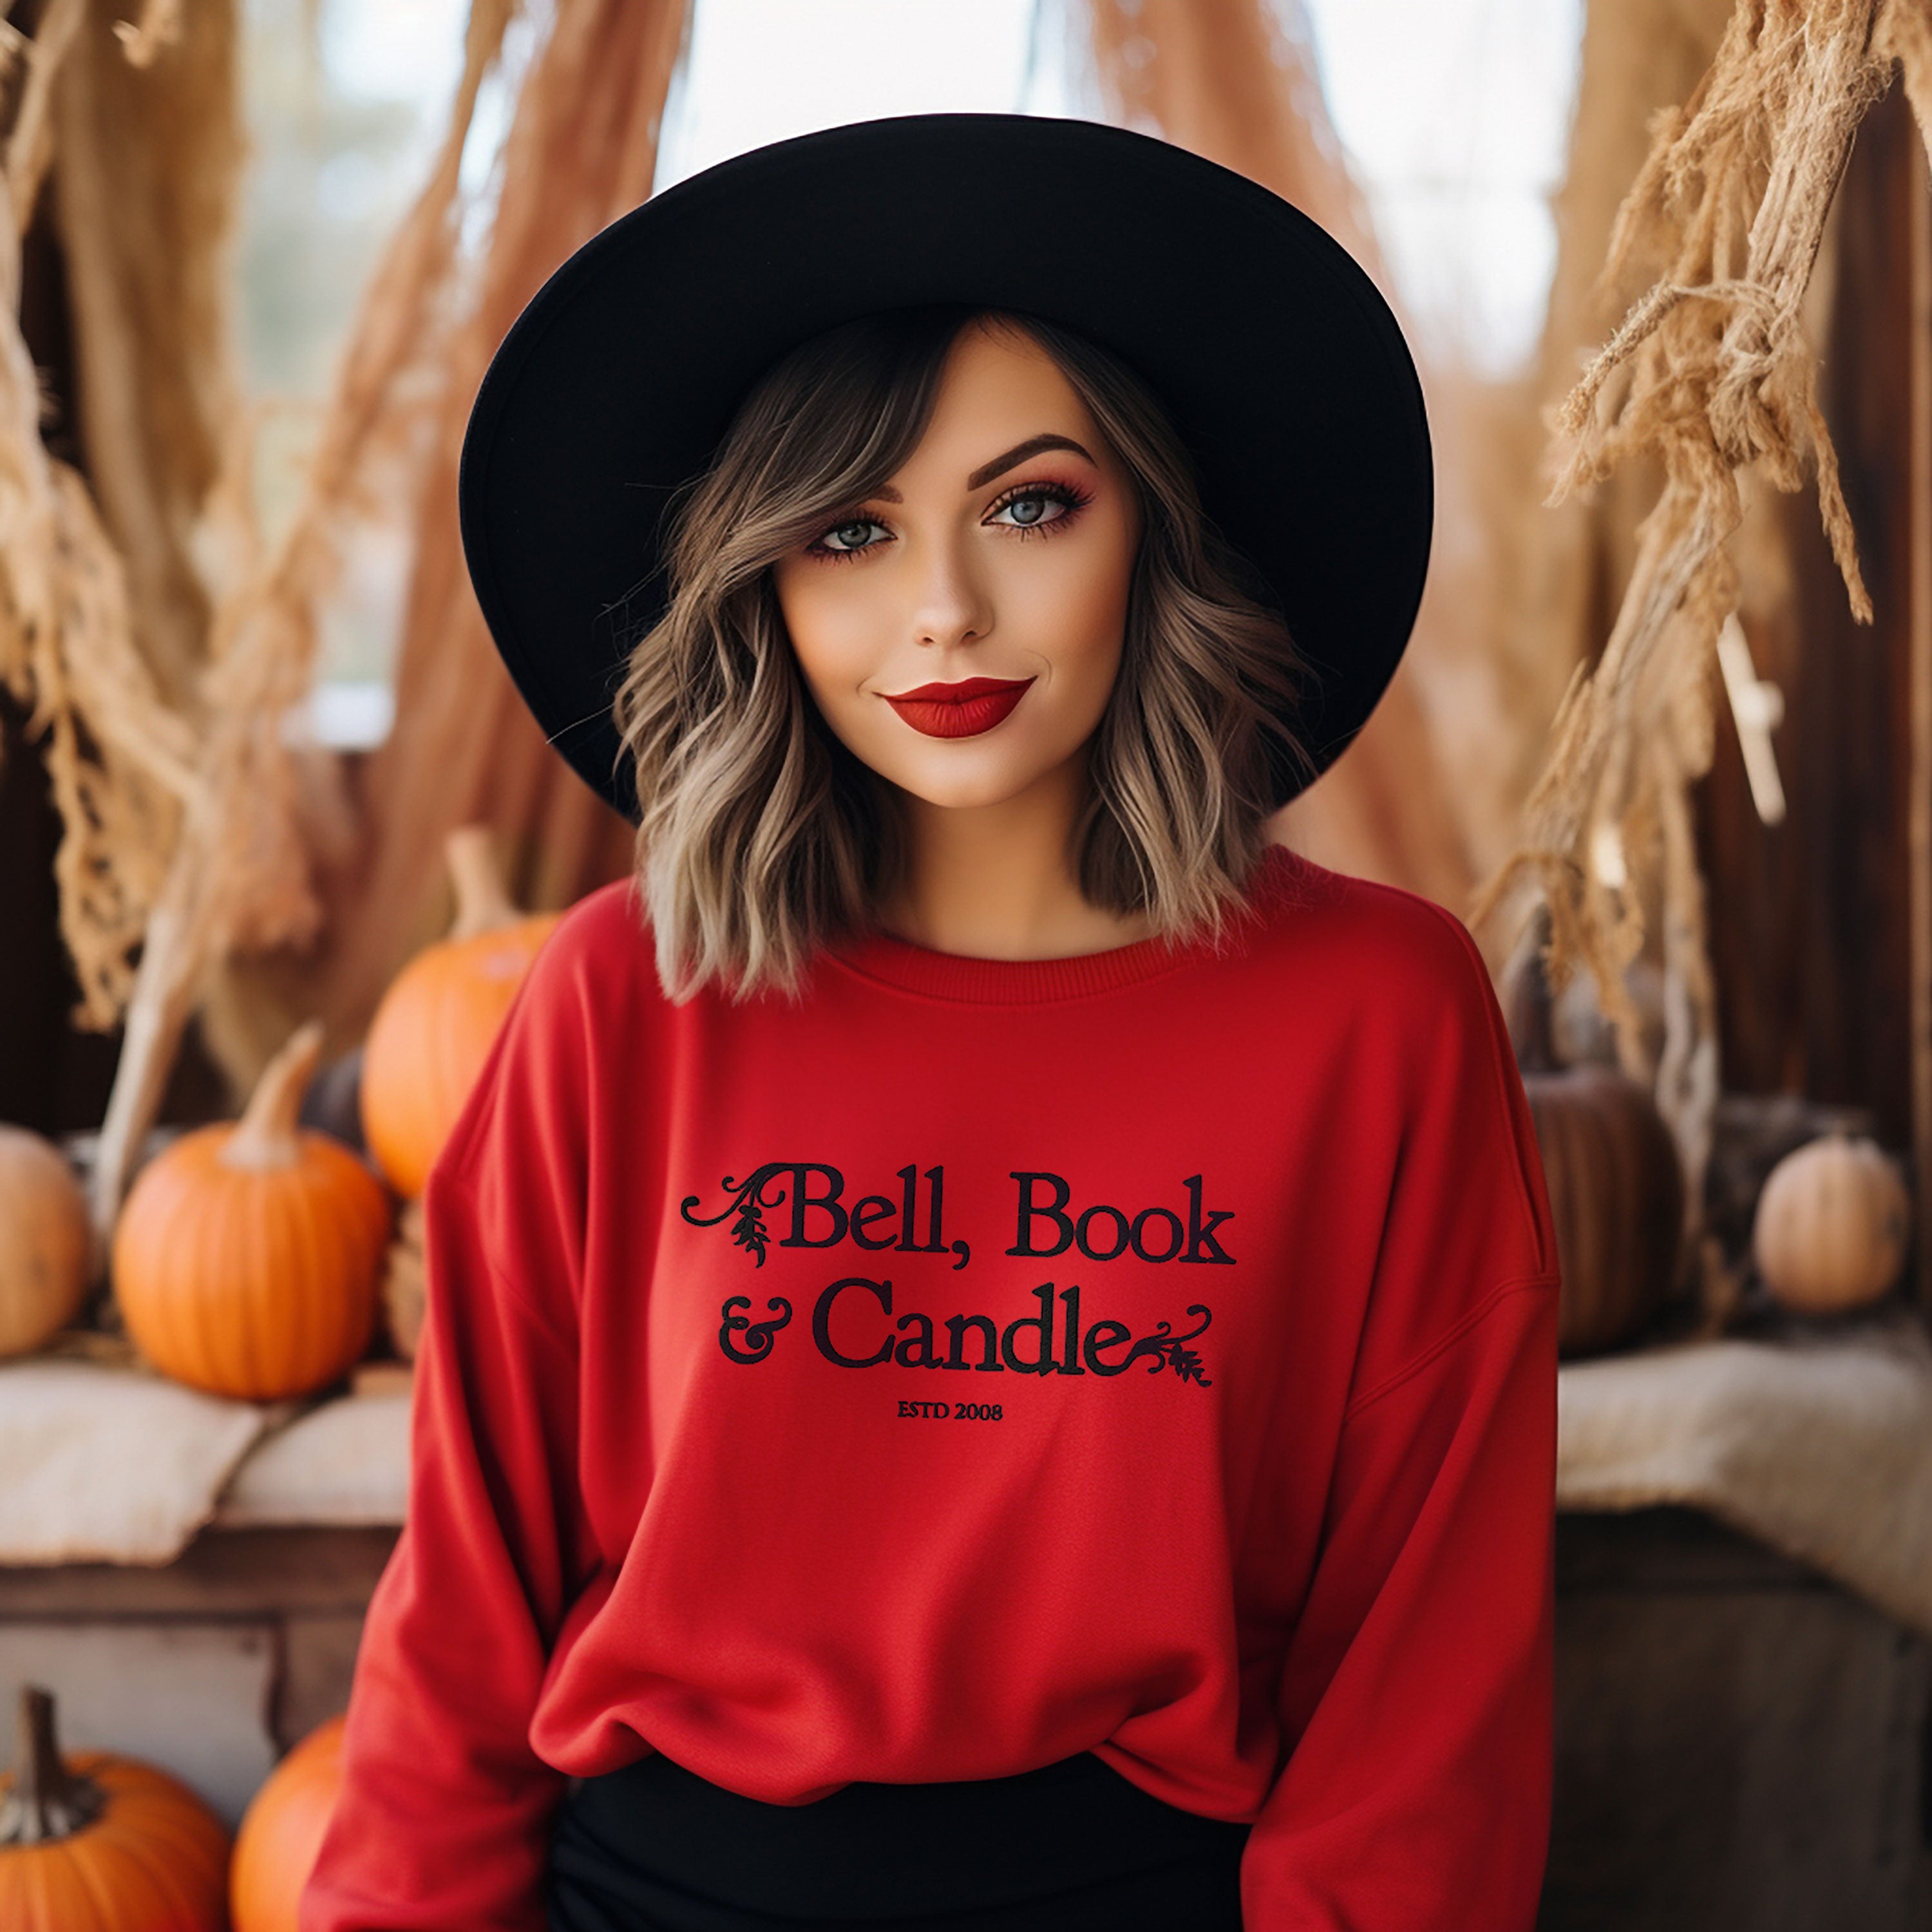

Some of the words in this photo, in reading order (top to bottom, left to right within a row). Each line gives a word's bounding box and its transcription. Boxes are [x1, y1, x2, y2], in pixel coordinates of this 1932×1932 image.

[759, 1162, 971, 1271] Bell,
[1005, 1171, 1237, 1265] Book
[719, 1296, 793, 1365] &
[812, 1278, 1137, 1378] Candle
[897, 1401, 950, 1419] ESTD
[954, 1403, 1003, 1421] 2008
